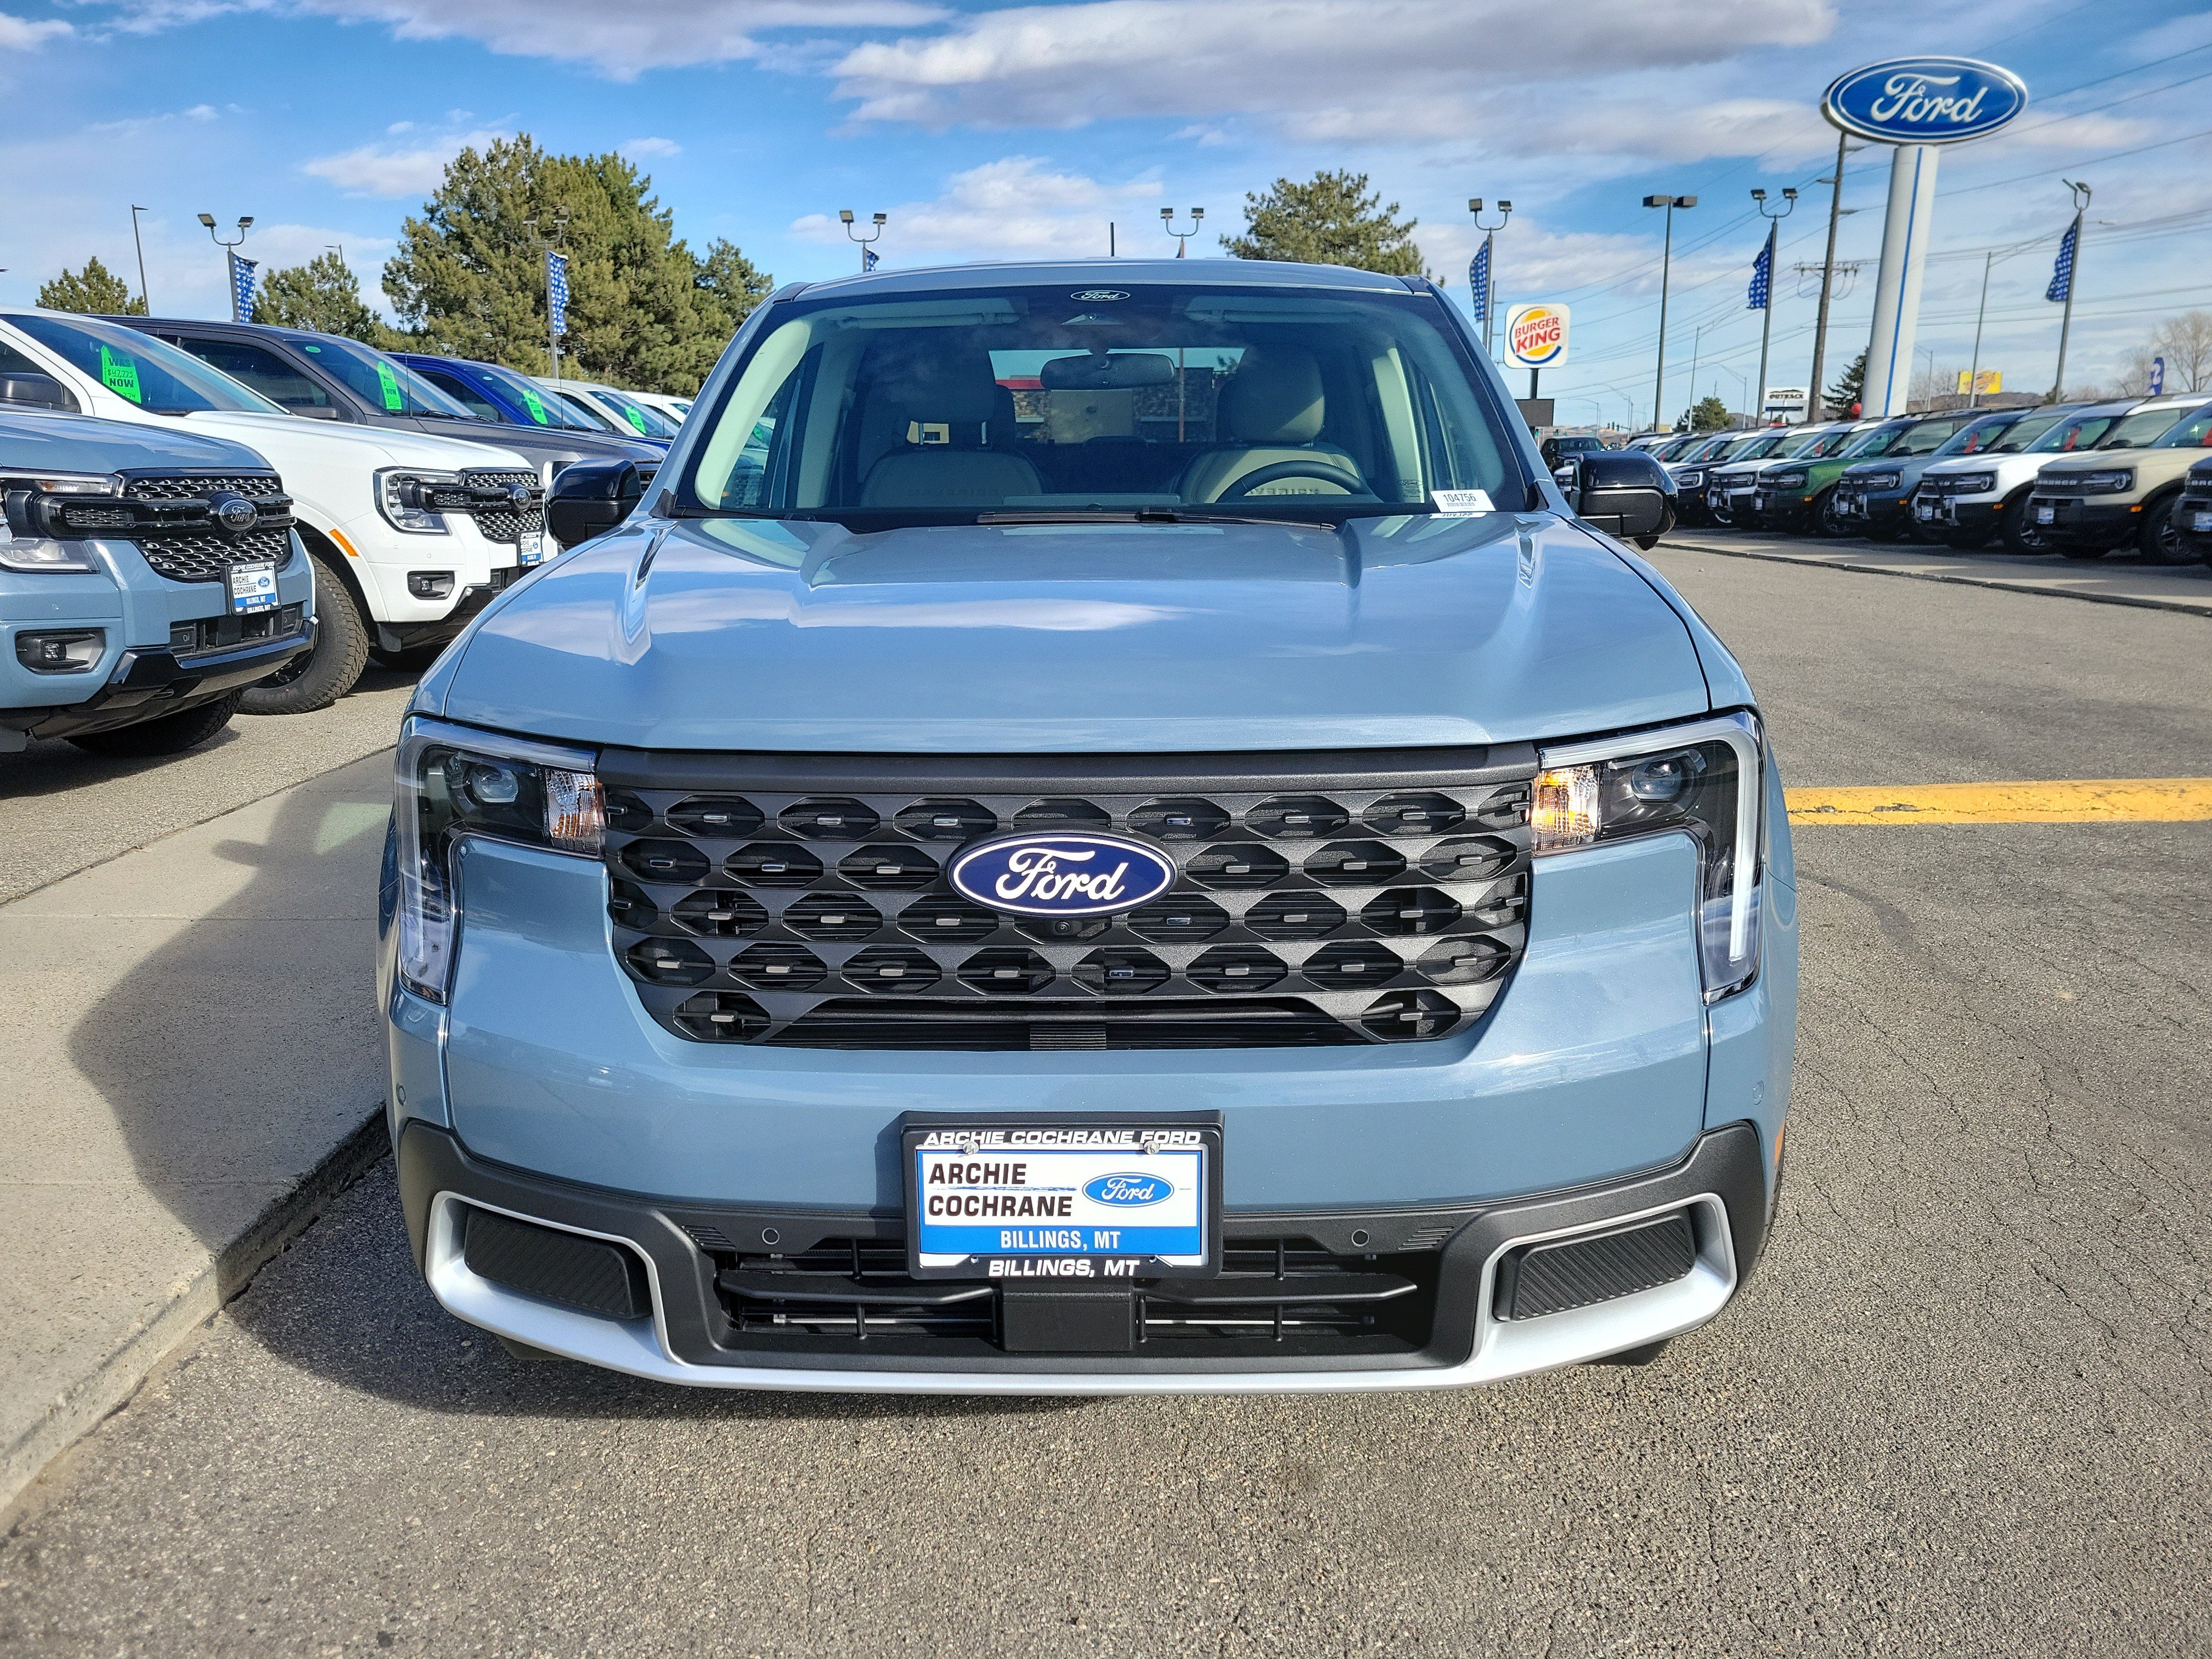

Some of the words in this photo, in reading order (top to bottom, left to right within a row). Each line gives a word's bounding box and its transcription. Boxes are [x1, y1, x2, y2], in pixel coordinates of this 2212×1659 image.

[1871, 73, 1988, 122] Ford
[1081, 291, 1120, 300] Ford
[1515, 317, 1559, 338] BURGER
[1516, 328, 1560, 353] KING
[110, 378, 133, 388] NOW
[1443, 493, 1476, 503] 104756
[230, 506, 252, 523] Ford
[233, 575, 250, 585] ARCHIE
[234, 585, 257, 595] COCHRANE
[995, 848, 1129, 900] Ford
[923, 1131, 1006, 1146] ARCHIE
[1011, 1130, 1135, 1144] COCHRANE
[1139, 1131, 1201, 1144] FORD
[928, 1163, 1027, 1184] ARCHIE
[1101, 1177, 1155, 1200] Ford
[928, 1195, 1073, 1217] COCHRANE
[1000, 1230, 1088, 1251] BILLINGS,
[1094, 1231, 1121, 1249] MT
[988, 1259, 1095, 1278] BILLINGS,
[1104, 1260, 1140, 1276] MT
